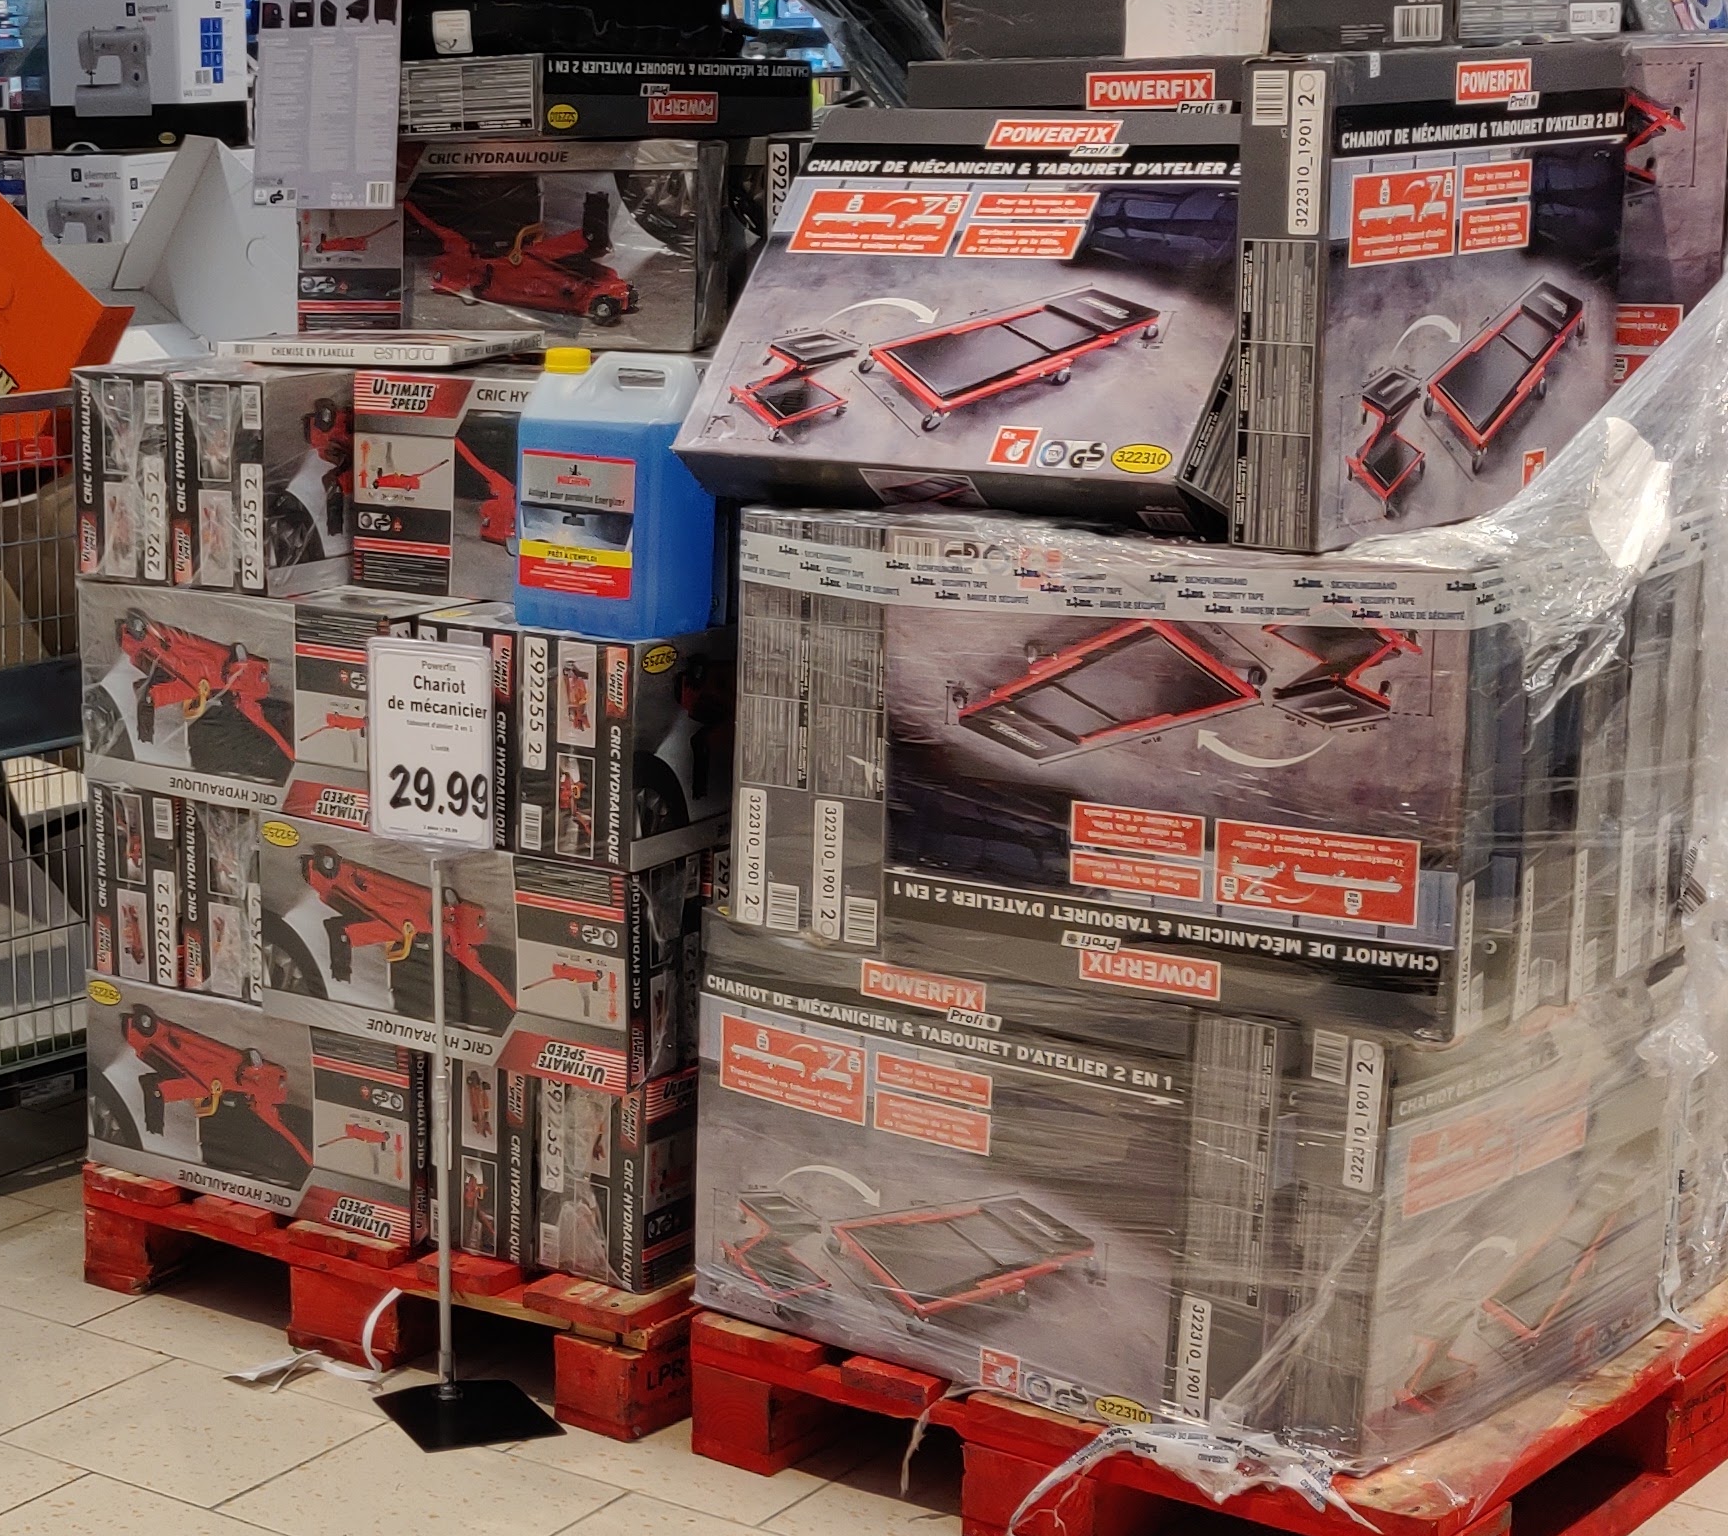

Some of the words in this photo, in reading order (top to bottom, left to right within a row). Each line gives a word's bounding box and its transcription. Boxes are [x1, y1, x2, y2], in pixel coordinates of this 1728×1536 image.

[556, 60, 570, 74] EN
[572, 60, 580, 73] 2
[582, 60, 632, 74] D'ATELIER
[635, 62, 685, 75] TABOURET
[756, 64, 770, 77] DE
[1093, 77, 1209, 101] POWERFIX
[1460, 68, 1526, 94] POWERFIX
[652, 98, 714, 115] POWERFIX
[1180, 101, 1213, 114] Profi
[1298, 94, 1315, 107] 2
[995, 126, 1113, 143] POWERFIX
[1341, 129, 1391, 149] CHARIOT
[1394, 128, 1410, 146] DE
[1412, 122, 1478, 144] MÉCANICIEN
[1479, 124, 1488, 139] &
[1490, 117, 1543, 138] TABOURET
[1545, 114, 1595, 133] D'ATELIER
[1596, 113, 1604, 128] 2
[1605, 113, 1618, 128] EN
[1620, 111, 1625, 126] 1
[428, 152, 467, 165] CRIC
[470, 150, 569, 165] HYDRAULIQUE
[1075, 143, 1109, 156] Profi
[807, 159, 881, 174] CHARIOT
[885, 160, 906, 175] DE
[913, 157, 1014, 175] MÉCANICIEN
[1017, 161, 1032, 175] &
[1037, 161, 1128, 176] TABOURET
[1136, 161, 1228, 176] D'ATELIER
[1230, 161, 1242, 176] 2
[1294, 117, 1314, 228] 322310_1901
[272, 346, 304, 357] CHEMISE
[306, 346, 316, 357] EN
[372, 378, 434, 399] ULTIMATE
[477, 389, 508, 402] CRIC
[390, 398, 427, 411] SPEED
[1002, 430, 1017, 440] 6x
[1116, 450, 1167, 465] 322310
[83, 478, 93, 505] CRIC
[244, 477, 258, 490] 2
[175, 486, 187, 513] CRIC
[413, 674, 466, 695] Chariot
[529, 645, 546, 733] 292255
[387, 694, 405, 711] de
[495, 710, 506, 746] CRIC
[528, 741, 542, 755] 2
[610, 724, 621, 759] CRIC
[169, 777, 248, 800] HYDRAULIQUE
[251, 790, 278, 806] CRIC
[323, 790, 357, 805] SPEED
[388, 764, 488, 820] 29.99
[494, 747, 507, 847] HYDRAULIQUE
[607, 761, 622, 864] HYDRAULIQUE
[92, 787, 108, 878] HYDRAULIQUE
[745, 794, 762, 888] 322310_1901
[820, 806, 838, 901] 322310_1901
[98, 879, 108, 908] CRIC
[158, 883, 170, 896] 2
[892, 881, 901, 896] 1
[905, 885, 930, 902] EN
[935, 888, 947, 903] 2
[188, 893, 198, 922] CRIC
[744, 895, 760, 907] 2
[952, 890, 1046, 919] D'ATELIER
[631, 875, 641, 974] HYDRAULIQUE
[819, 909, 837, 921] 2
[1050, 903, 1152, 934] TABOURET
[1159, 920, 1174, 934] &
[156, 902, 172, 979] 292255
[1079, 935, 1117, 951] Profi
[1177, 922, 1302, 959] MÉCANICIEN
[1308, 942, 1336, 959] DE
[1088, 952, 1213, 990] POWERFIX
[1343, 948, 1439, 973] CHARIOT
[633, 977, 641, 1009] CRIC
[868, 970, 980, 1010] POWERFIX
[950, 1010, 984, 1027] Profi
[706, 974, 770, 1003] CHARIOT
[773, 991, 795, 1008] DE
[797, 996, 898, 1035] MÉCANICIEN
[901, 1021, 915, 1037] &
[919, 1024, 1010, 1059] TABOURET
[1016, 1047, 1108, 1080] D'ATELIER
[1112, 1066, 1126, 1082] 2
[1131, 1068, 1159, 1087] EN
[1164, 1074, 1172, 1091] 1
[460, 1039, 493, 1056] CRIC
[546, 1042, 586, 1061] SPEED
[539, 1054, 606, 1085] ULTIMATE
[1356, 1061, 1375, 1075] 2
[1350, 1083, 1371, 1184] 322310_1901
[510, 1134, 521, 1165] CRIC
[622, 1158, 634, 1188] CRIC
[178, 1169, 262, 1200] HYDRAULIQUE
[264, 1192, 292, 1208] CRIC
[338, 1198, 375, 1214] SPEED
[331, 1209, 391, 1238] ULTIMATE
[509, 1168, 521, 1263] HYDRAULIQUE
[619, 1191, 634, 1290] HYDRAULIQUE
[1185, 1304, 1206, 1402] 322310_1901
